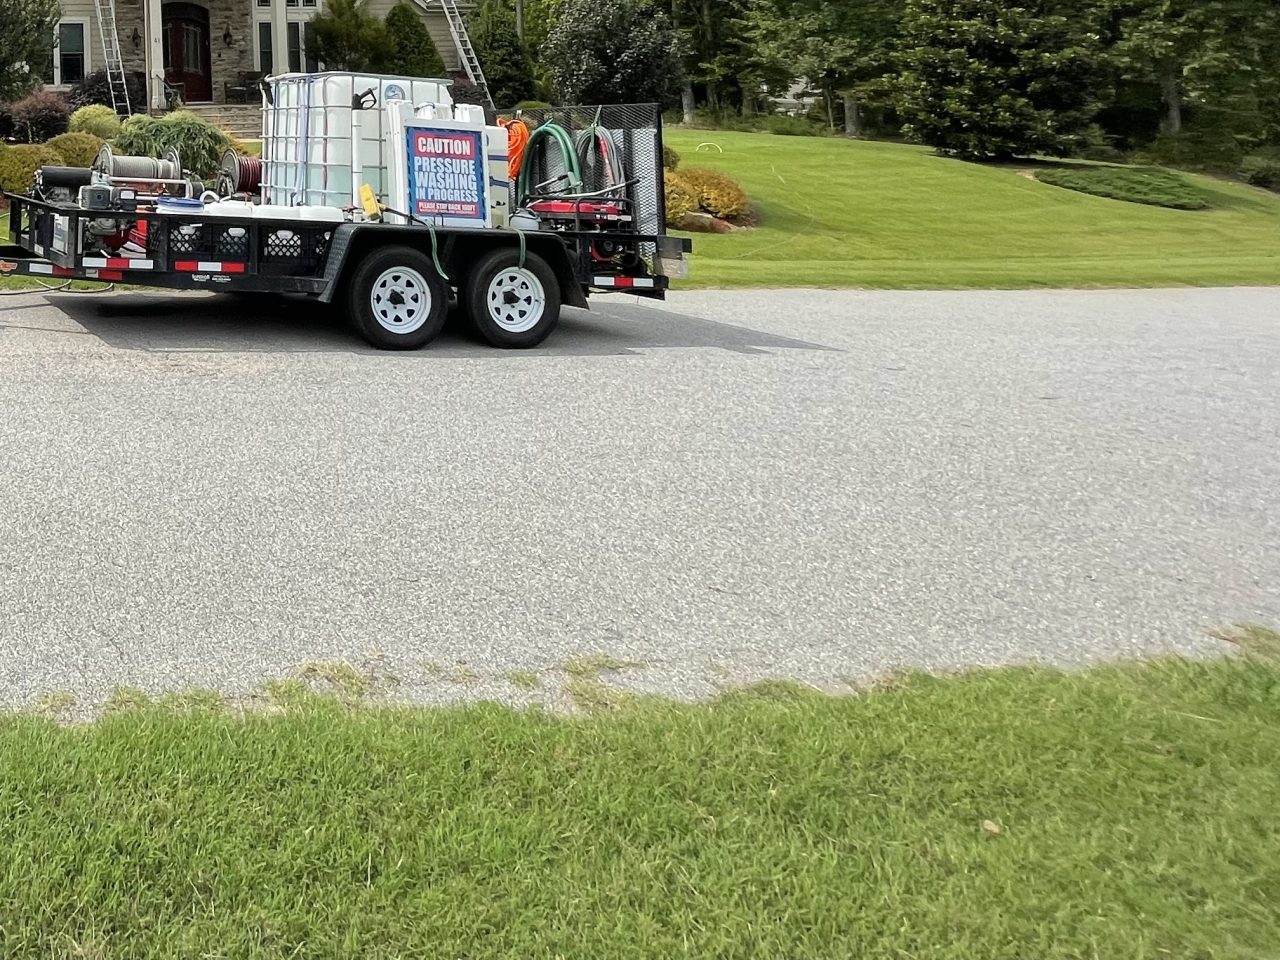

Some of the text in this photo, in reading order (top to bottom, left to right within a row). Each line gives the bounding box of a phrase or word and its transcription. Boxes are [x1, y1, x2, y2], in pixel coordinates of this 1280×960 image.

[418, 137, 471, 155] CAUTION
[414, 157, 476, 175] PRESSURE
[414, 171, 478, 190] WASHING
[415, 187, 478, 202] IN PROGRESS
